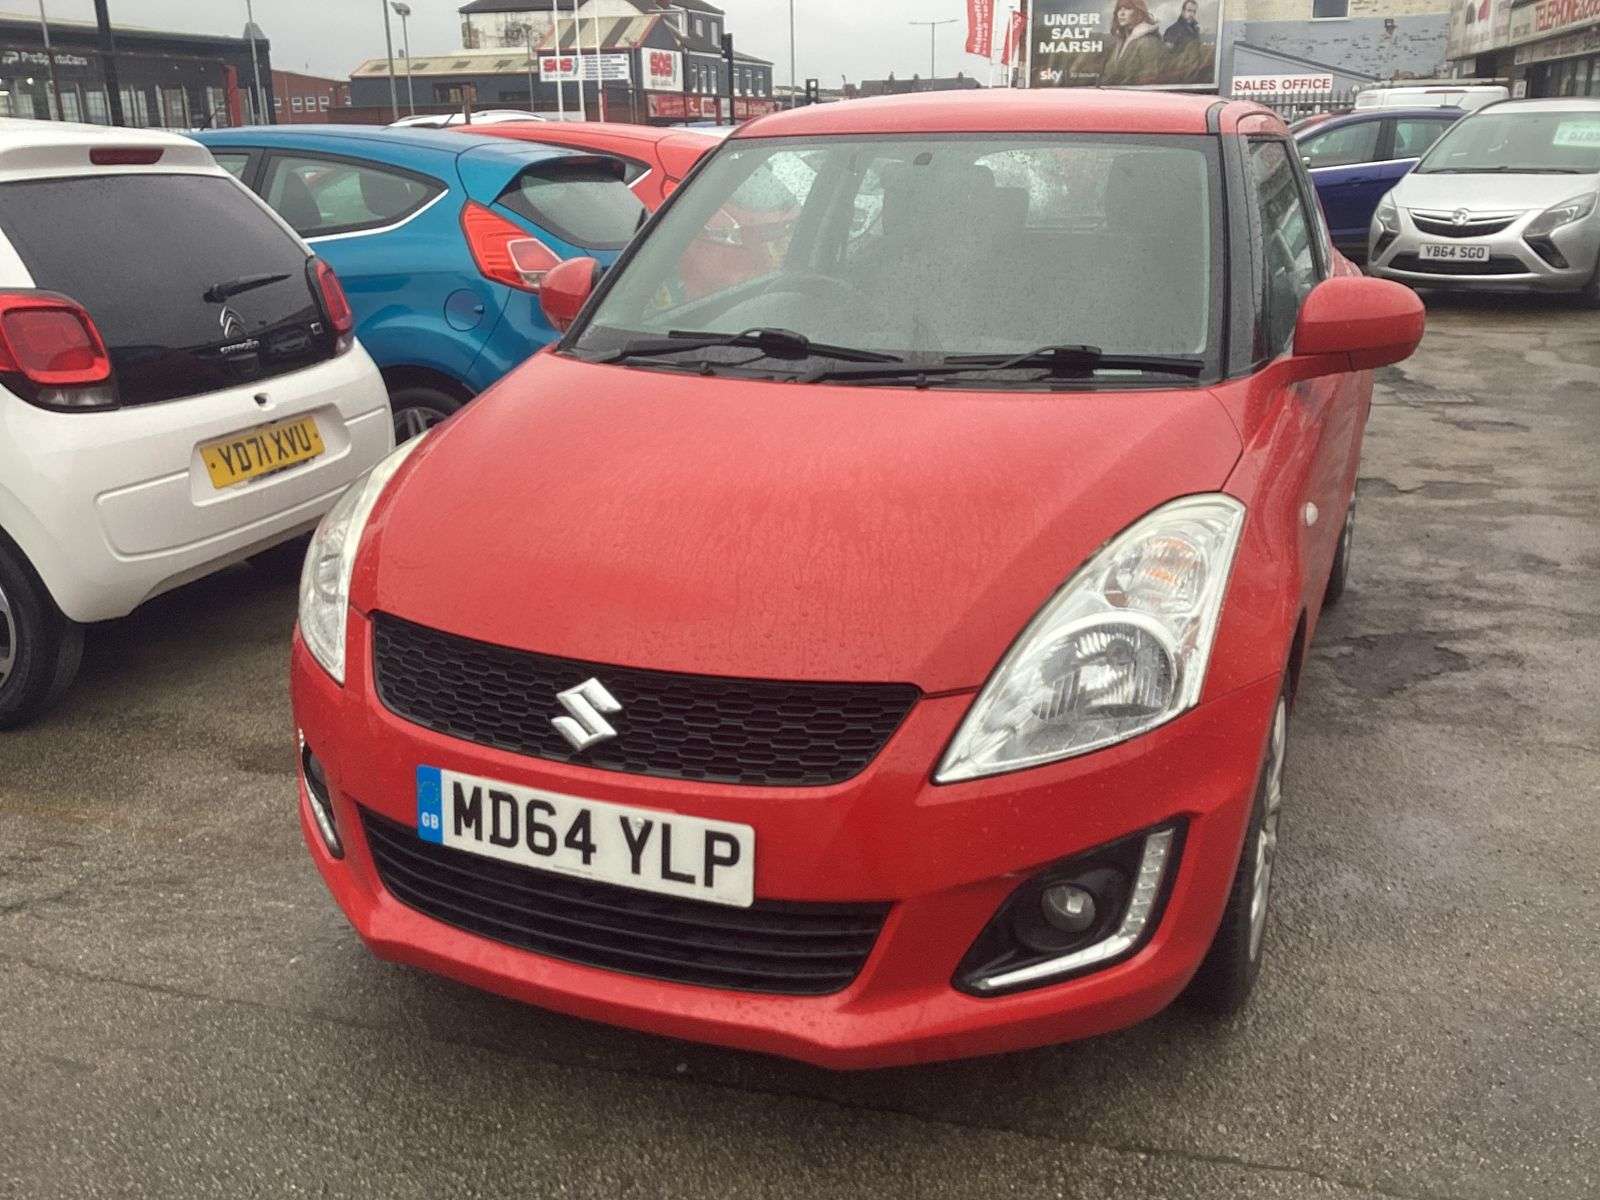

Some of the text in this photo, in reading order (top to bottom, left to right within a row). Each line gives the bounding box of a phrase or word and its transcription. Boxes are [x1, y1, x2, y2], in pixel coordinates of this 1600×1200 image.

[1044, 12, 1100, 26] UNDER
[1051, 27, 1093, 39] SALT
[1039, 40, 1103, 53] MARSH
[1040, 67, 1063, 83] sky
[1234, 78, 1331, 91] SALES OFFICE
[1425, 245, 1485, 259] YB64 SGO
[218, 423, 312, 476] YD71 XVU
[421, 810, 440, 830] GB
[452, 781, 741, 888] MD64 YLP
